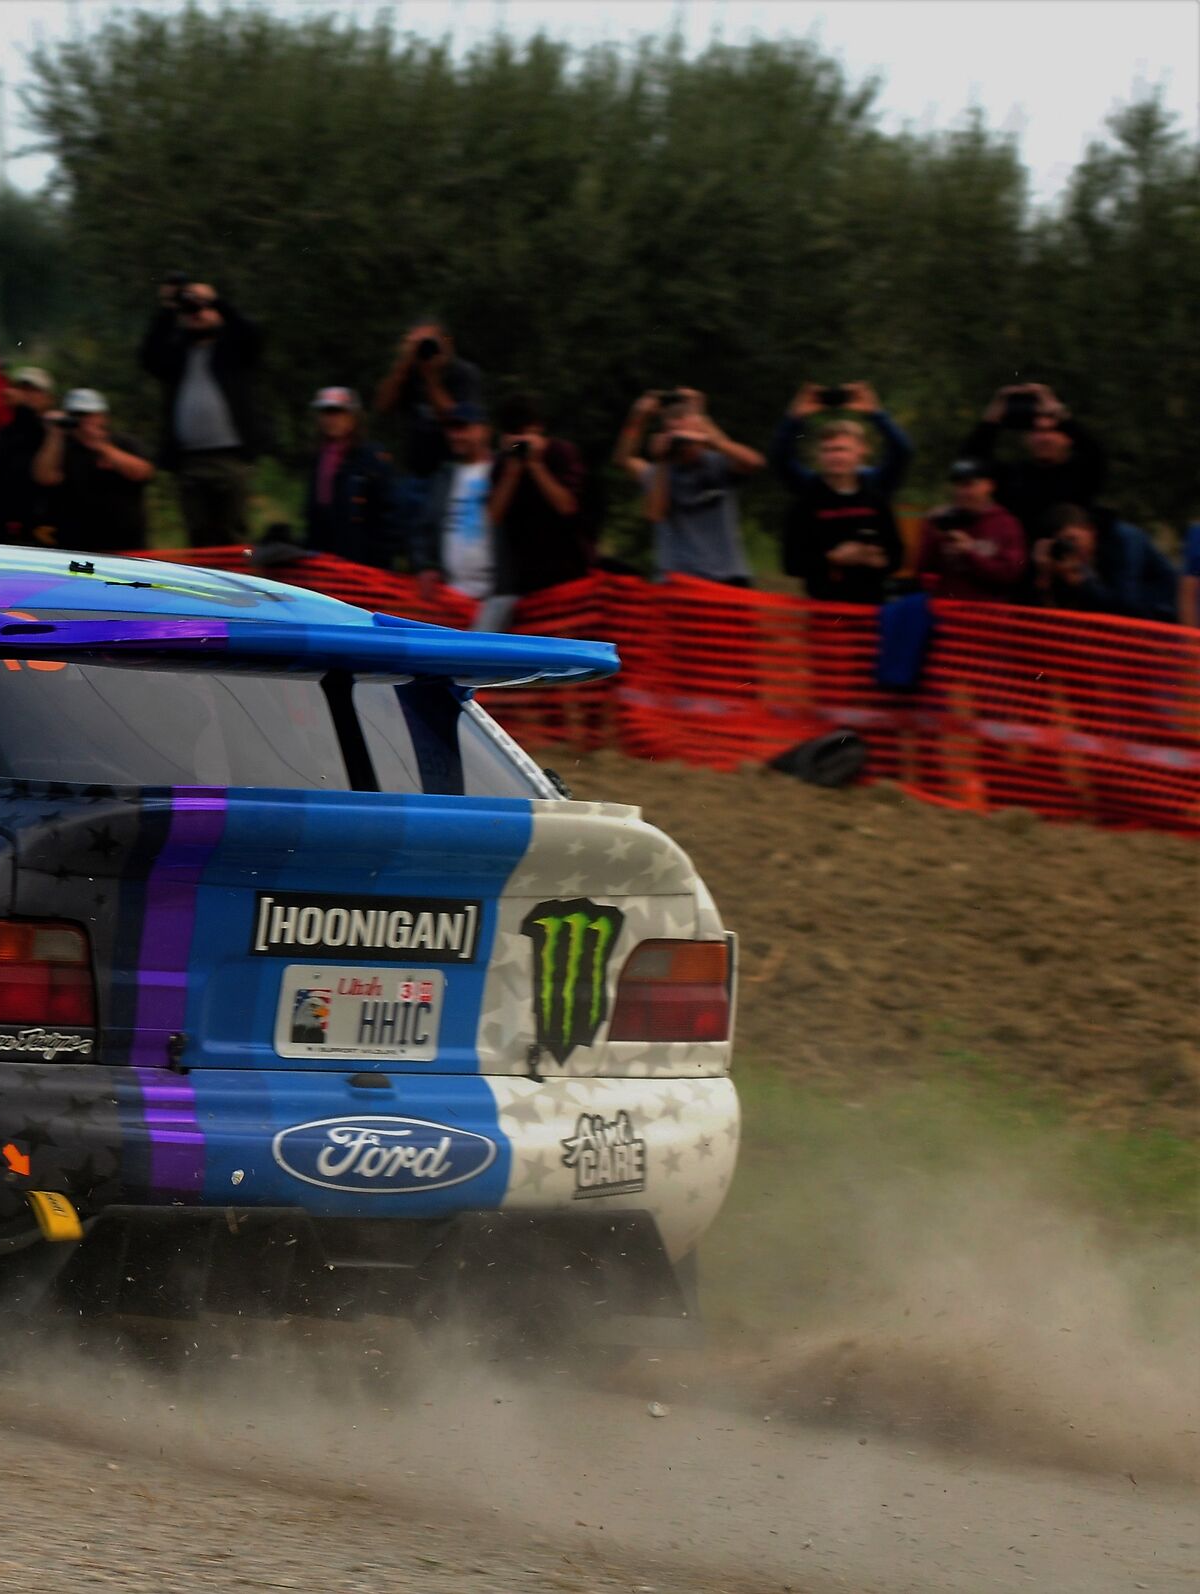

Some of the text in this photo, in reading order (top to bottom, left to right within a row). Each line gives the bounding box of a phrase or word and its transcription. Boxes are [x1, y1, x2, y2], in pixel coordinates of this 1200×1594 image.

[337, 976, 383, 996] Utah
[357, 1001, 432, 1045] HHIC
[316, 1125, 452, 1179] Ford
[578, 1140, 644, 1187] CARE
